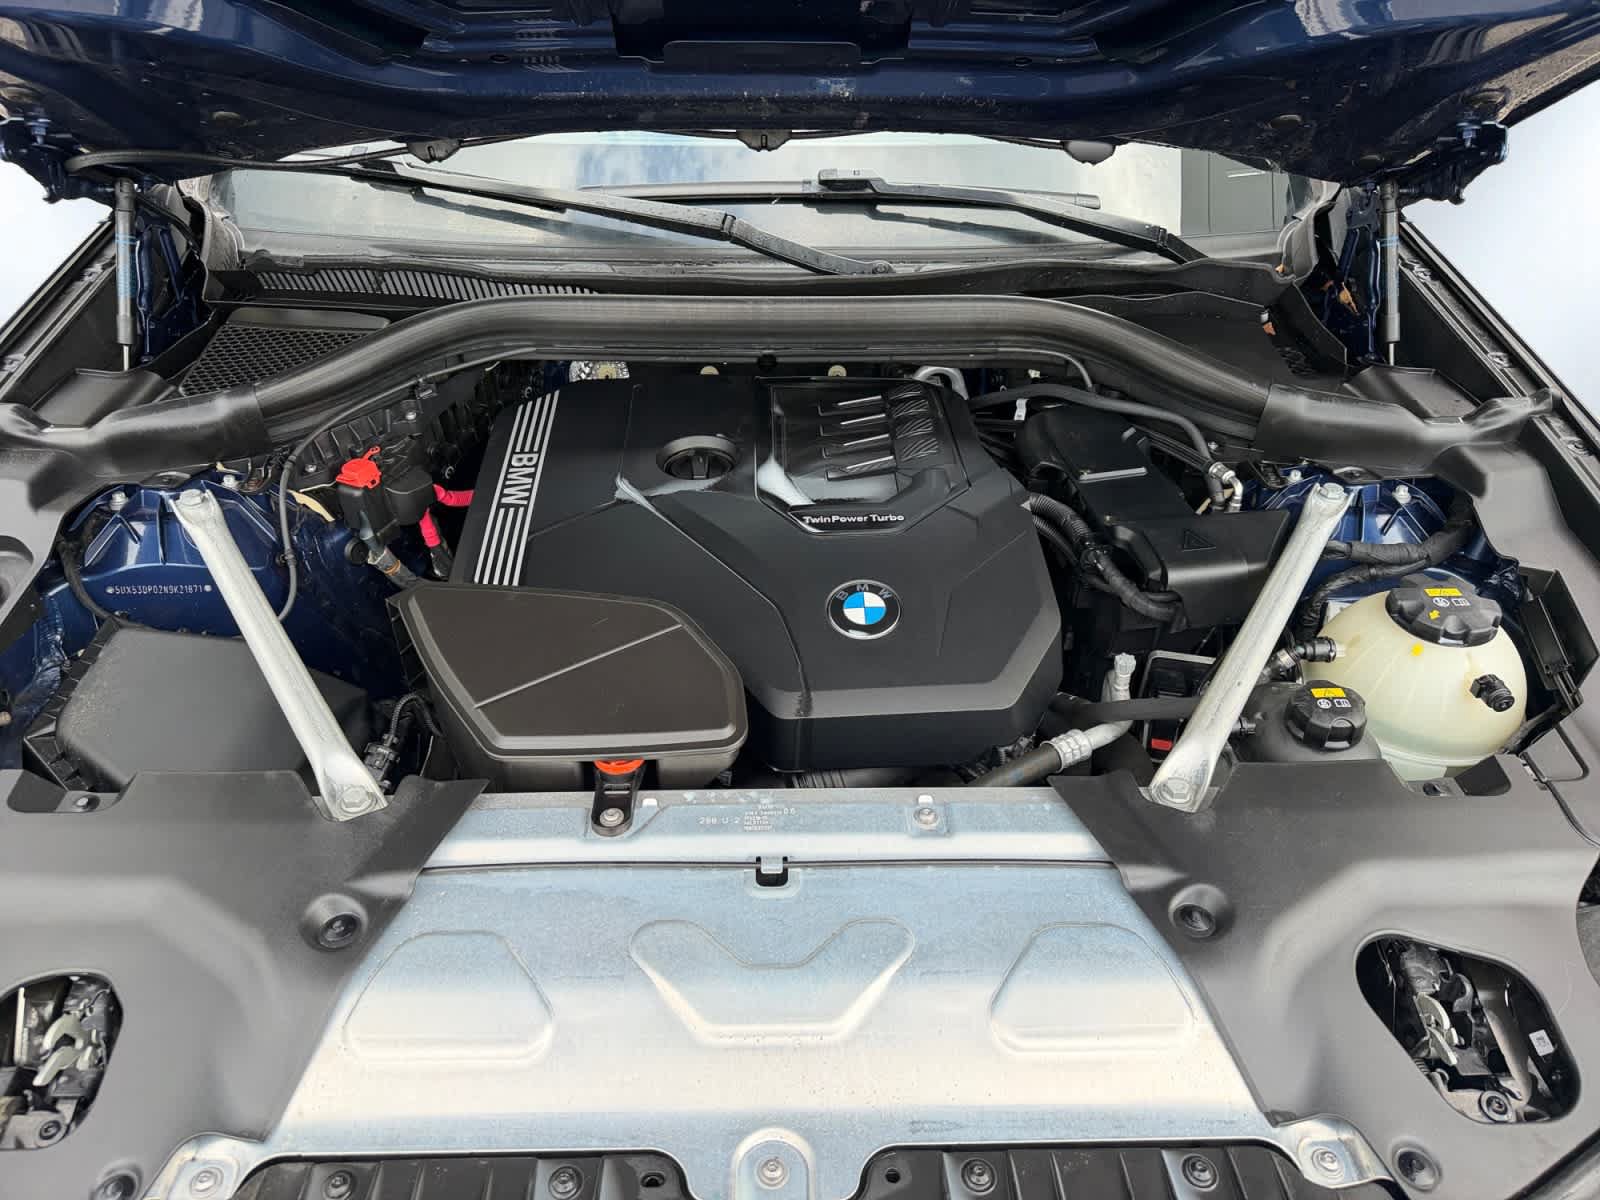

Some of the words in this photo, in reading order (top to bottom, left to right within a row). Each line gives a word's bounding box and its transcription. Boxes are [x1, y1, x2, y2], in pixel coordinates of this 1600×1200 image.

[501, 453, 539, 504] BMW
[869, 513, 905, 521] Turbo
[835, 583, 893, 601] BMW
